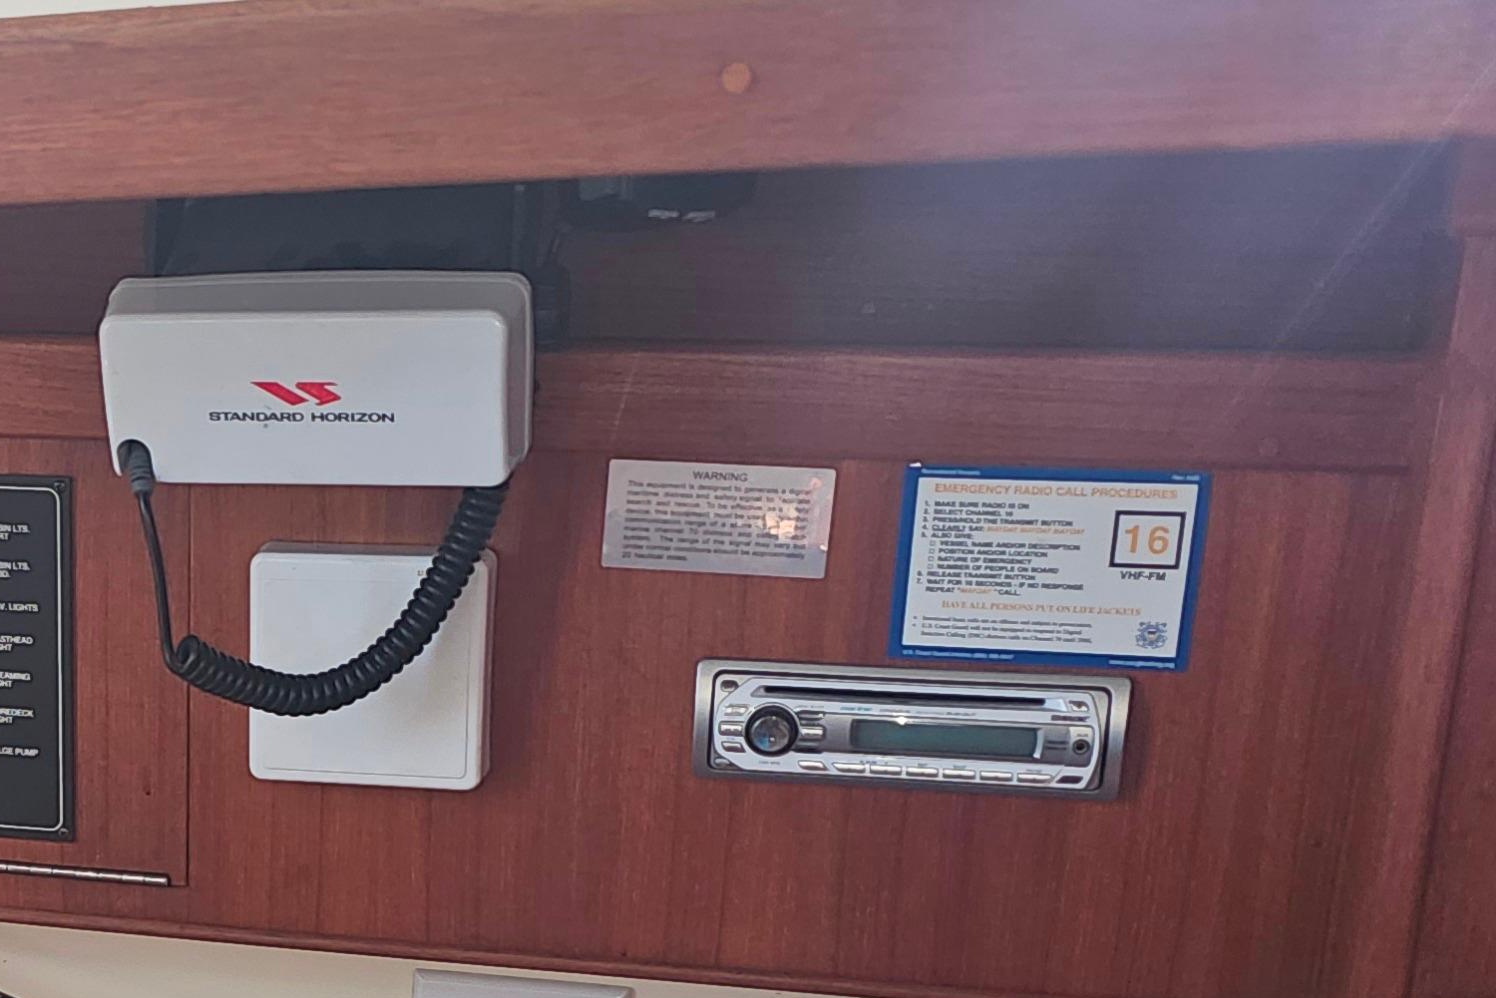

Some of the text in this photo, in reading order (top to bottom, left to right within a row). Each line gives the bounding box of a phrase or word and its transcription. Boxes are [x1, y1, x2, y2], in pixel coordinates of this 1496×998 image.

[209, 412, 395, 422] STANDARD HORIZON
[692, 471, 748, 482] WARNING
[934, 483, 1178, 499] EMERGENCY RADIO CALL PROCEDURES
[934, 508, 964, 516] SELECT
[1000, 518, 1039, 526] TRANSMIT
[12, 525, 30, 533] LTS.
[932, 524, 966, 532] CLEARLY
[1124, 524, 1170, 555] 16
[1008, 550, 1048, 558] LOCATION
[12, 562, 30, 571] LTS.
[984, 564, 1015, 572] PEOPLE
[927, 570, 962, 578] RELEASE
[1120, 570, 1166, 581] VHF-FM
[975, 580, 1012, 588] SECONDS
[1041, 583, 1084, 591] RESPONSE
[8, 602, 38, 612] LIGHTS
[942, 600, 967, 609] HAVE
[970, 602, 988, 610] ALL
[990, 602, 1034, 612] PERSONS
[1035, 604, 1054, 612] PUT
[1056, 604, 1070, 612] ON
[1096, 606, 1142, 616] JACKETS
[15, 747, 40, 757] PUMP
